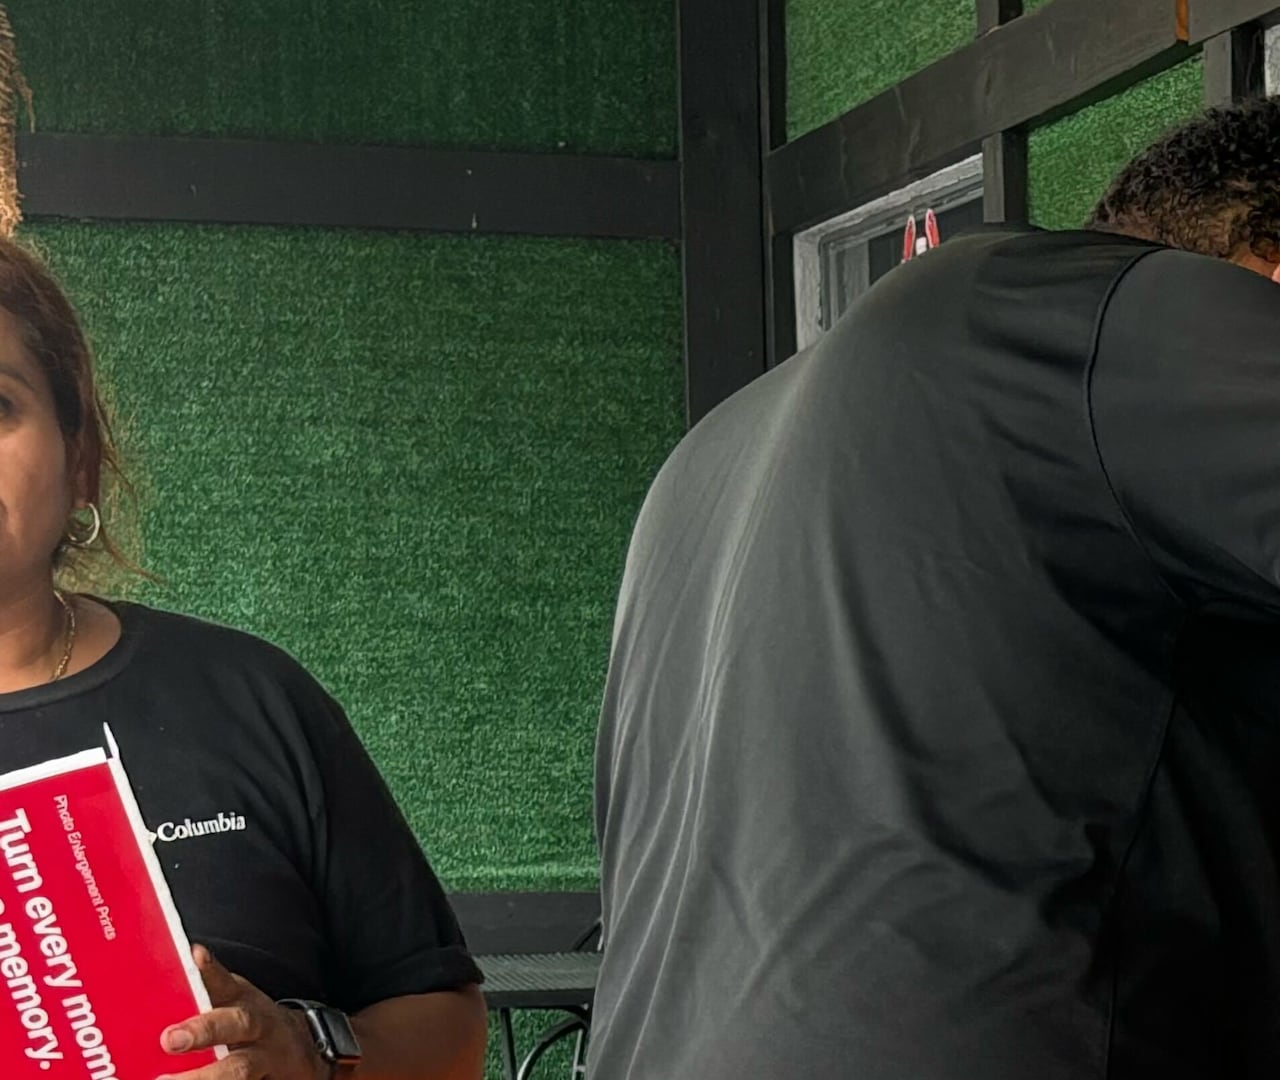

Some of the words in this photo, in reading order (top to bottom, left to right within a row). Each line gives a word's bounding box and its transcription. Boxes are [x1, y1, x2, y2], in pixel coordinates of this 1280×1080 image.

[0, 807, 43, 893] Turn
[25, 896, 83, 988] every
[53, 794, 75, 832] Photo
[67, 831, 105, 906] Enlargement
[96, 906, 117, 941] Prints
[156, 811, 247, 842] Columbia
[0, 922, 64, 1070] memory.
